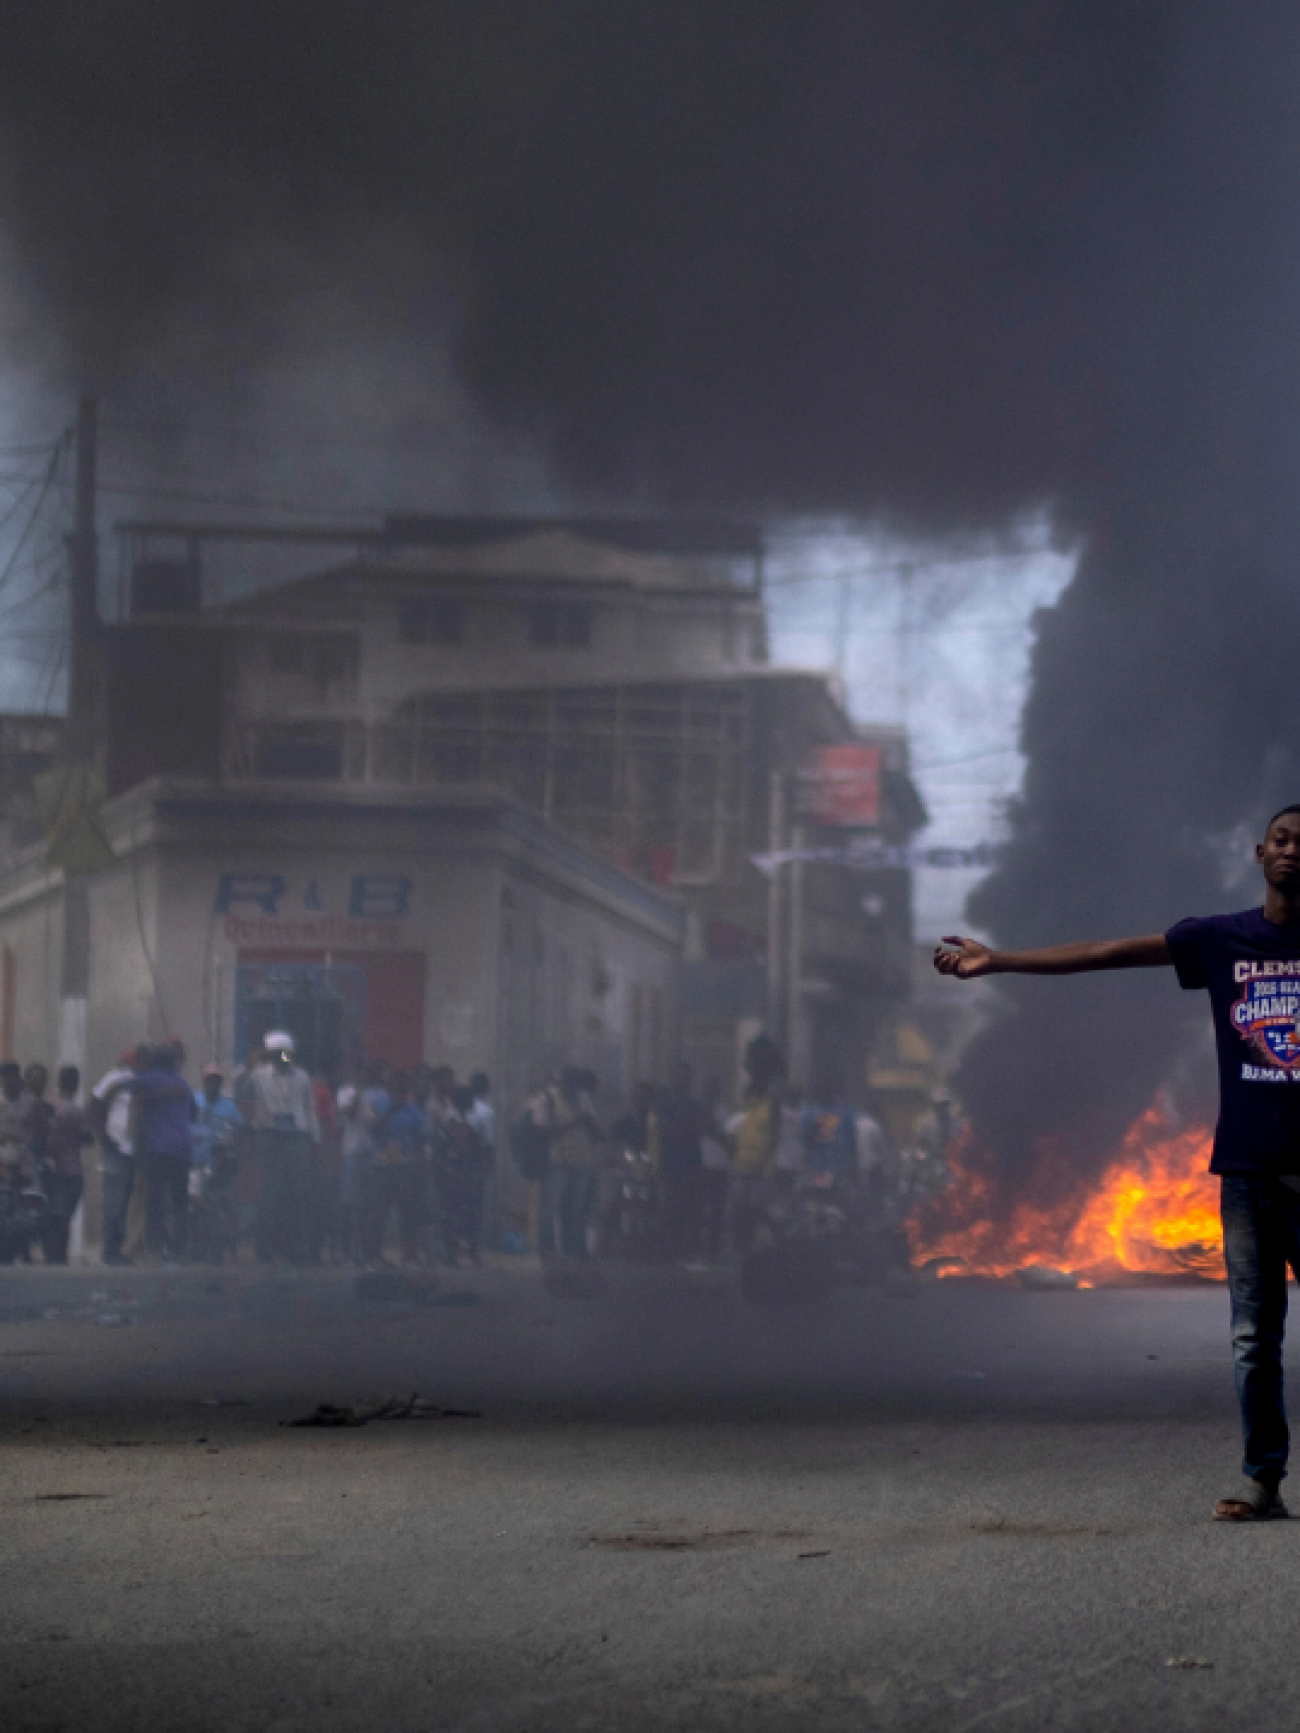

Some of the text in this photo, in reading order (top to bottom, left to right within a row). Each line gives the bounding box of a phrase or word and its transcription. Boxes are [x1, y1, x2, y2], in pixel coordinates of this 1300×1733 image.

[215, 874, 285, 917] R
[349, 876, 413, 918] B
[1240, 1063, 1287, 1081] BAMA
